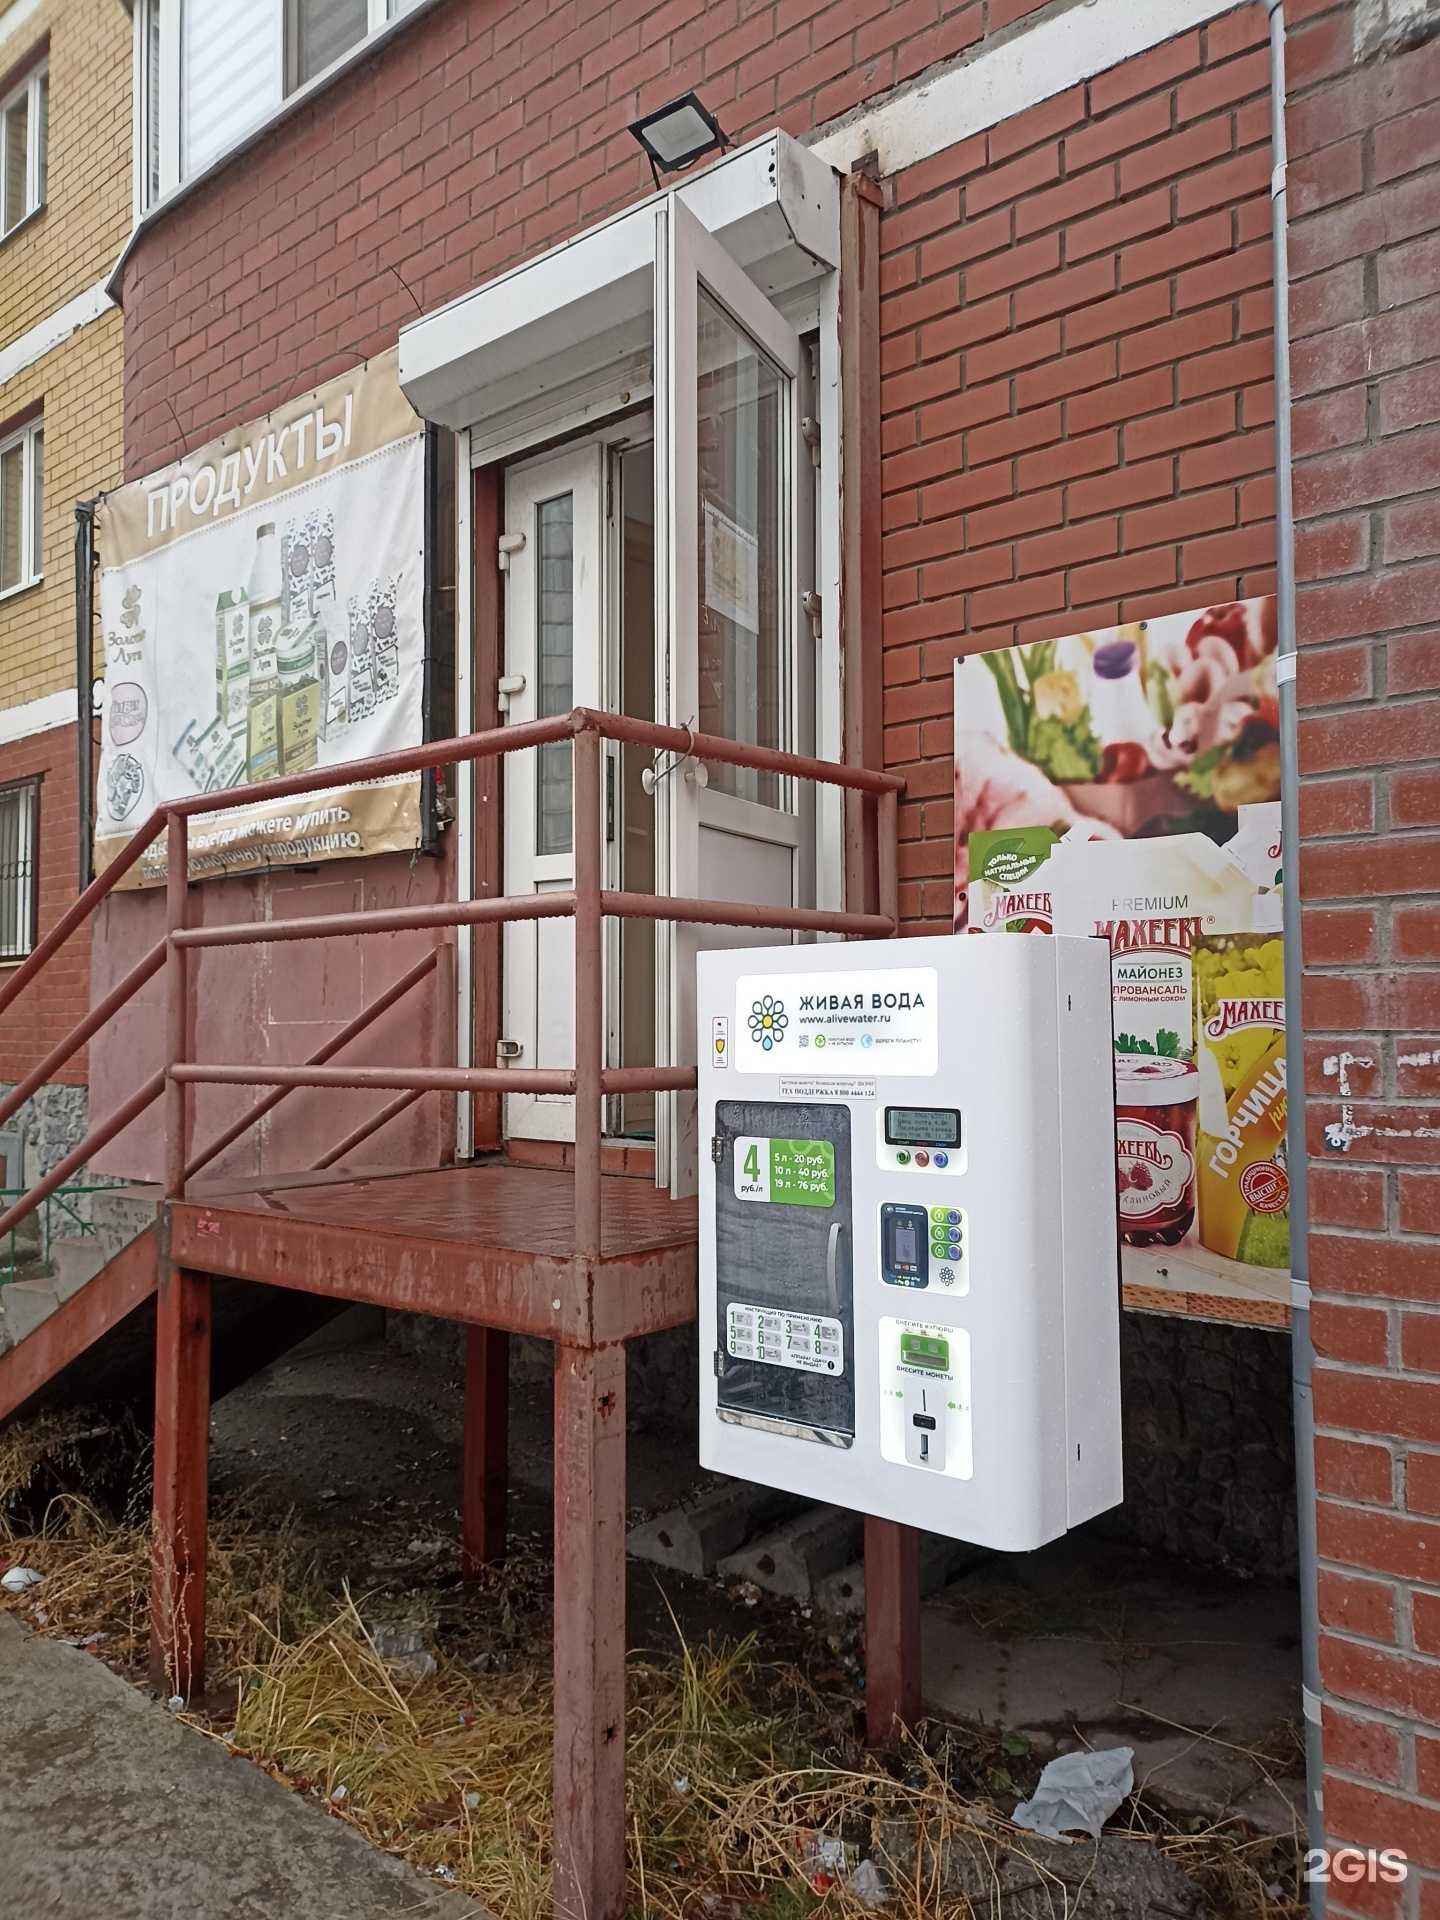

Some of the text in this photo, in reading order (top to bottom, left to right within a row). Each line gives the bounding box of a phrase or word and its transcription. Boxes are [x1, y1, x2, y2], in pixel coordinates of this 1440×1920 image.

[146, 393, 352, 537] ПРОДУКТЫ
[239, 816, 292, 838] можете
[295, 806, 351, 833] купить
[271, 831, 361, 861] продукцию
[984, 856, 1037, 877] НАТУРАЛЬНЫЕ
[987, 853, 1018, 868] ТОЛЬКО
[999, 866, 1029, 881] СПЕЦИИ
[984, 892, 1052, 927] МАХЕЕВ
[1112, 895, 1188, 911] PREMIUM
[1117, 965, 1183, 980] МАЙОНЕЗ
[1113, 985, 1187, 995] ПРОВАНСАЛЬ
[799, 992, 925, 1011] ЖИВАЯ ВОДА
[799, 1013, 891, 1024] www.alivewater.ru
[1208, 1001, 1285, 1036] МАХЕЕ
[1208, 1056, 1287, 1179] ГОРЧИЦА
[743, 1144, 760, 1182] 4
[774, 1152, 780, 1162] 5
[794, 1155, 804, 1163] 20
[807, 1155, 825, 1166] руб.
[775, 1166, 783, 1175] 10
[798, 1168, 809, 1177] 40
[811, 1168, 829, 1179] руб.
[741, 1184, 763, 1193] руб./л
[775, 1179, 783, 1188] 19
[798, 1181, 808, 1189] 76
[810, 1181, 829, 1193] руб.
[730, 1311, 735, 1324] 1
[758, 1315, 764, 1329] 2
[730, 1326, 736, 1340] 5
[785, 1320, 792, 1334] 3
[814, 1324, 821, 1339] 4
[758, 1330, 764, 1344] 6
[786, 1335, 792, 1350] 7
[730, 1341, 736, 1354] 9
[756, 1346, 765, 1360] 10
[814, 1340, 821, 1354] 8
[897, 1366, 953, 1380] ВНЕСИТЕ МОНЕТЫ
